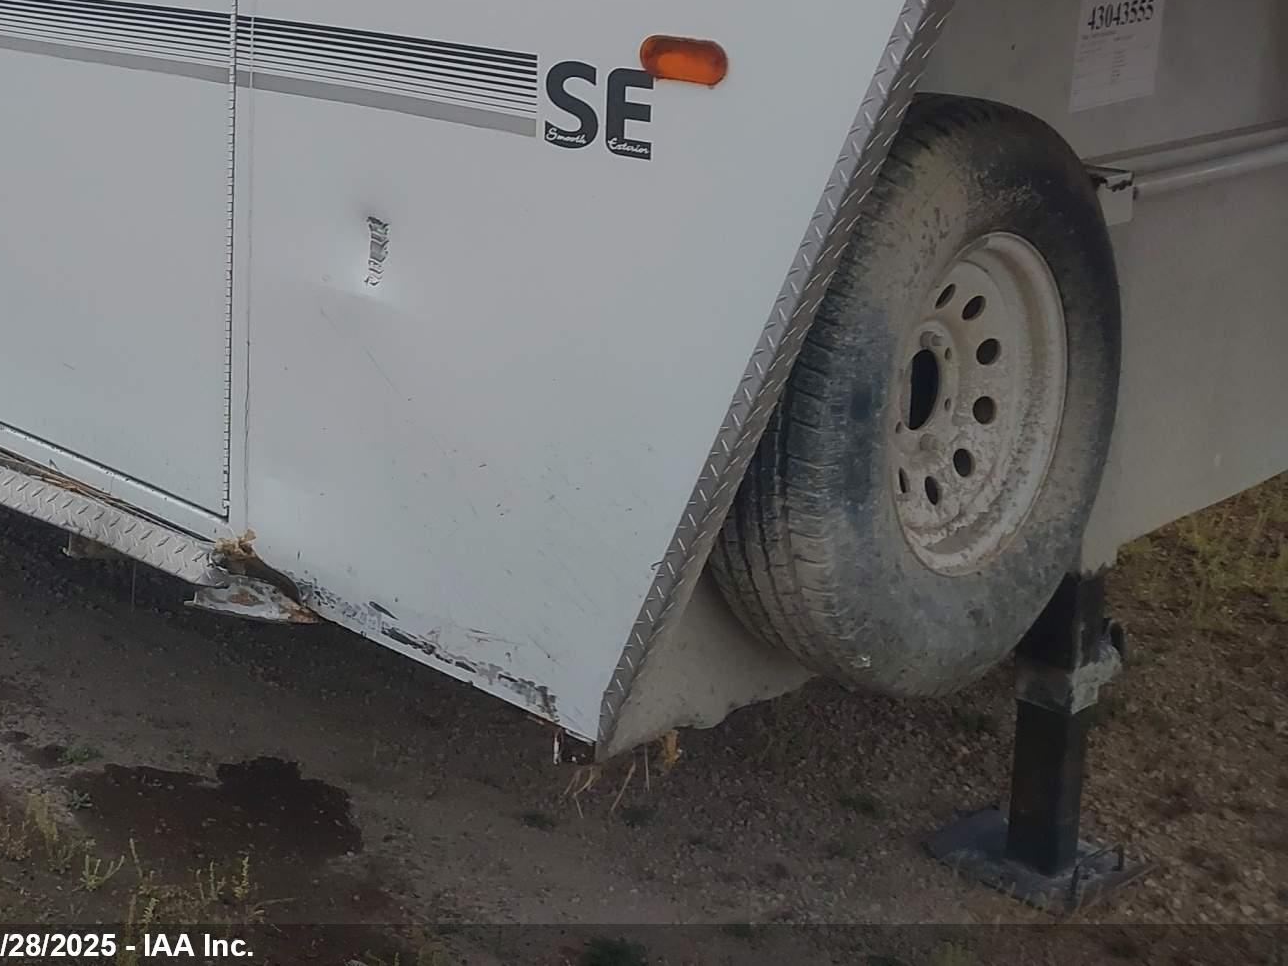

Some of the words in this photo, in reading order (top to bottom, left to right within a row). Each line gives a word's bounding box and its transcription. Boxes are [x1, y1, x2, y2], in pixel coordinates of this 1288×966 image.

[545, 60, 655, 161] SE
[546, 128, 587, 145] Smooth
[607, 137, 650, 155] Exterior
